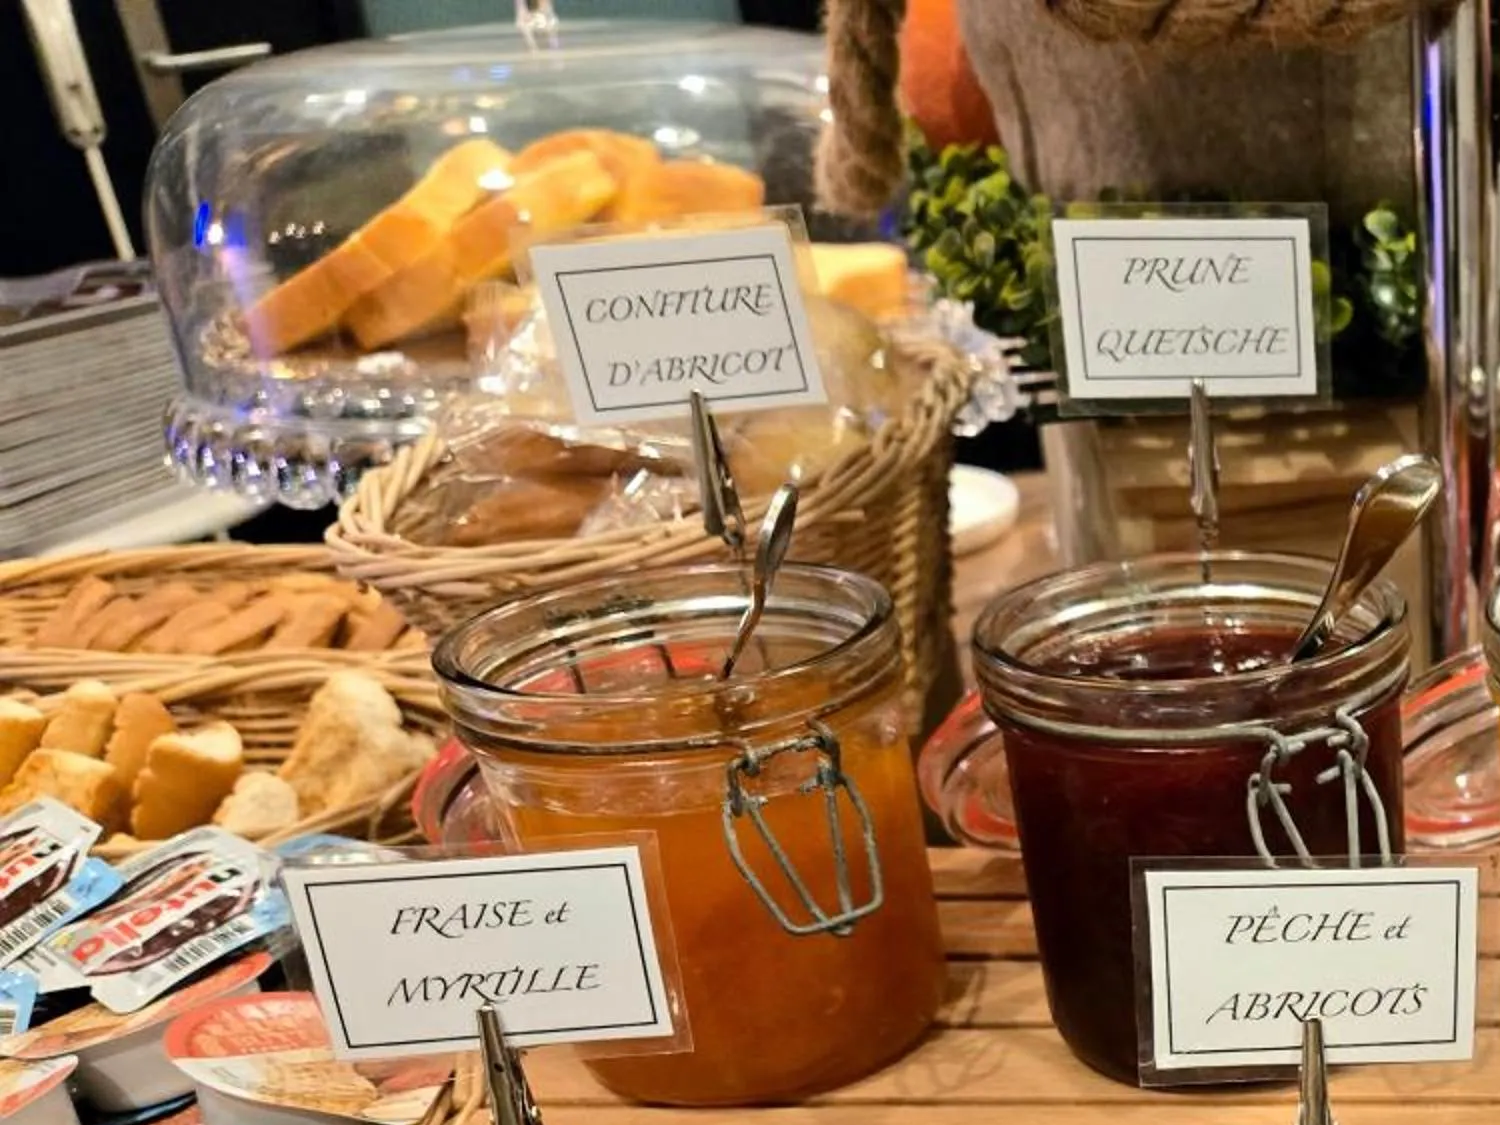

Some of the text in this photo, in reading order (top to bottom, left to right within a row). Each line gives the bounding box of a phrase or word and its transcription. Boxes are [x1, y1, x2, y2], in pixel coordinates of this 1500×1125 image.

[1123, 253, 1253, 292] PRUNE
[585, 283, 773, 323] CONFITURE
[1096, 325, 1290, 363] QUETSCHE
[608, 344, 796, 387] D'ABRICOT
[390, 899, 572, 939] FRAISE et
[1225, 905, 1413, 945] PÊCHE et
[387, 963, 601, 1006] MYRTILLE
[1205, 983, 1428, 1025] ABRICOTS
